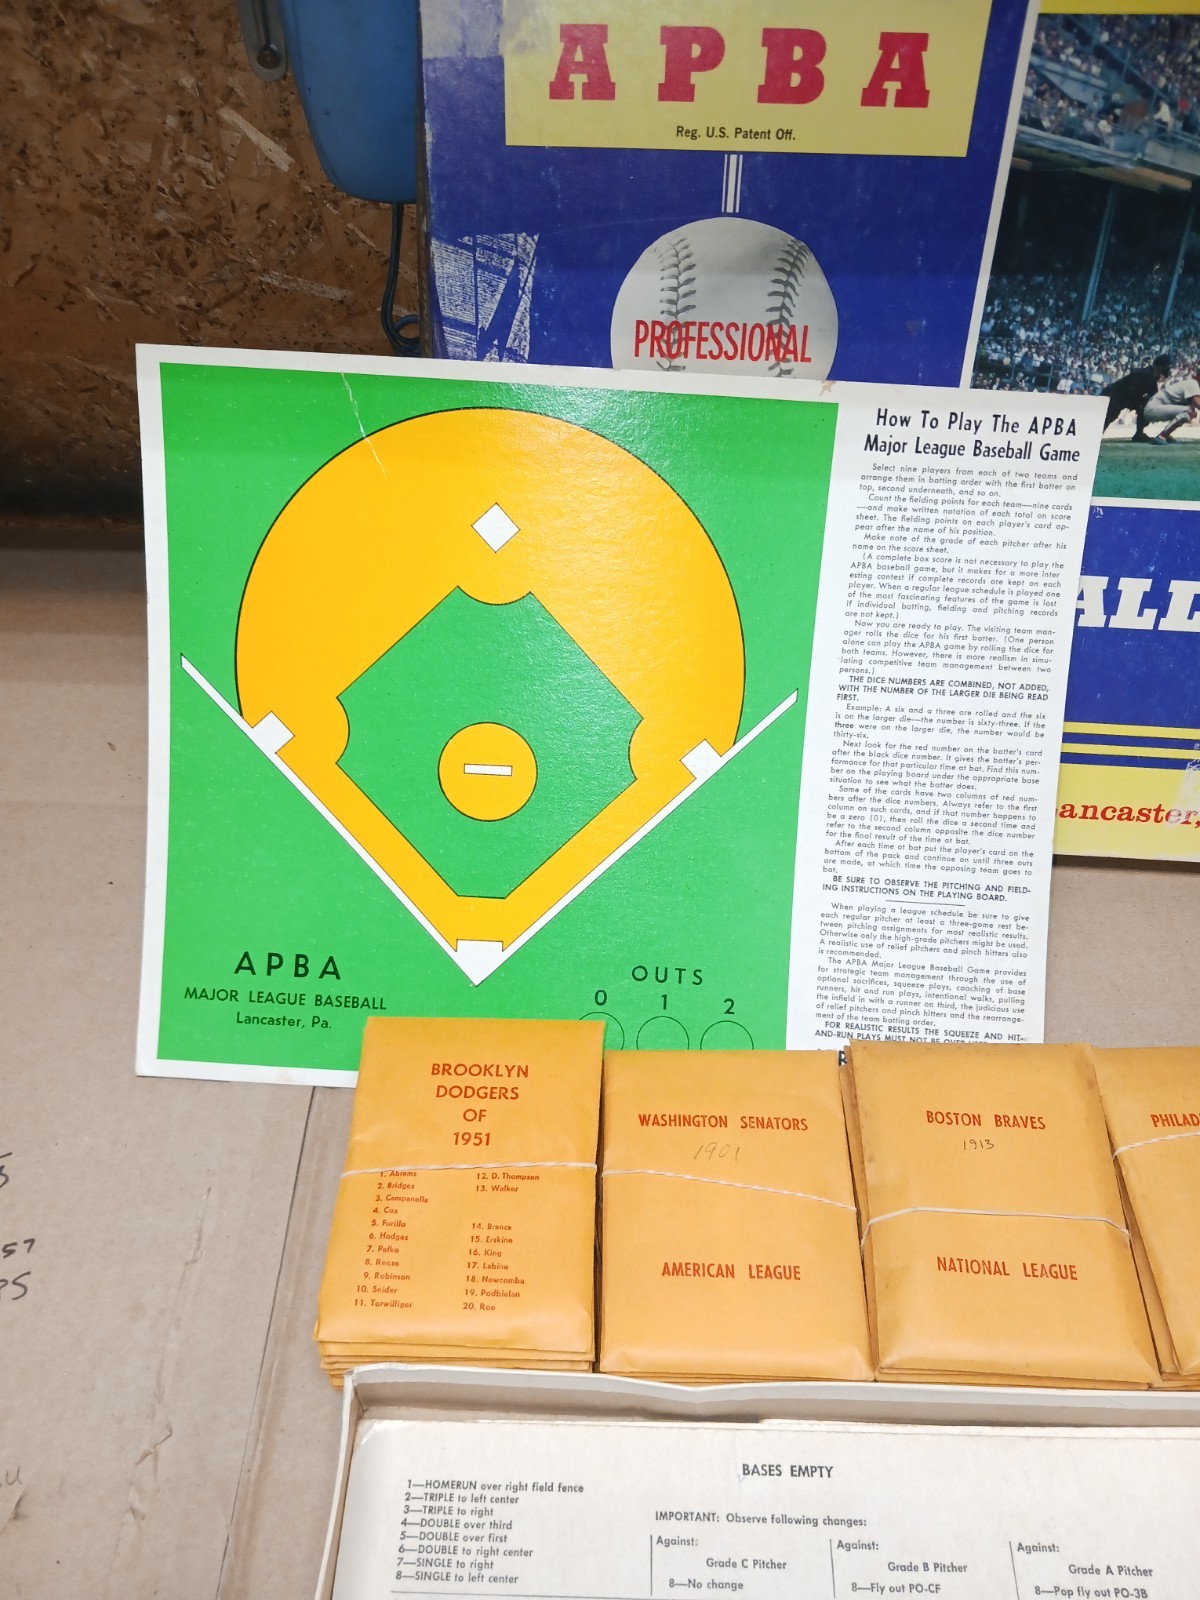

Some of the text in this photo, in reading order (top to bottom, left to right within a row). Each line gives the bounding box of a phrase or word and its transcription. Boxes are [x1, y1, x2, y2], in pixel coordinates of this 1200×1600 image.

[549, 23, 930, 108] APBA
[676, 126, 796, 142] Reg. U.S. Patent Off.
[634, 319, 812, 363] PROFESSIONAL
[876, 408, 1077, 436] How To Play The APBA
[864, 434, 1080, 462] Major League Baseball Game
[867, 676, 884, 684] DICE
[888, 677, 926, 686] NUMBERS
[930, 679, 945, 687] ARE
[948, 680, 994, 689] COMBINED,
[998, 682, 1016, 690] NOT
[1019, 683, 1049, 692] ADDED,
[1054, 803, 1200, 828] ancaster,
[847, 876, 866, 884] SURE
[869, 877, 880, 885] TO
[885, 878, 919, 887] OBSERVE
[924, 880, 938, 888] THE
[942, 881, 980, 891] PITCHING
[985, 884, 1003, 892] AND
[841, 885, 899, 895] INSTRUCTIONS
[903, 888, 916, 896] ON
[920, 889, 934, 897] THE
[938, 890, 973, 900] PLAYING
[977, 892, 1007, 901] BOARD.
[234, 951, 341, 980] APBA
[632, 965, 703, 985] OUTS
[184, 987, 386, 1010] MAJOR LEAGUE BASEBALL
[595, 990, 735, 1014] 0 1 2
[236, 1012, 331, 1029] Lancaster, Pa.
[431, 1063, 529, 1078] BROOKLYN
[436, 1085, 519, 1100] DODGERS
[463, 1109, 487, 1122] OF
[926, 1110, 1046, 1130] BOSTON BRAVES
[638, 1114, 808, 1131] WASHINGTON SENATORS
[453, 1132, 491, 1146] 1951
[964, 1139, 995, 1150] 1913
[694, 1141, 740, 1161] 1901
[502, 1173, 539, 1181] Thompson
[380, 1233, 409, 1241] Hodges
[367, 1245, 374, 1253] 7.
[484, 1249, 502, 1257] King
[661, 1262, 801, 1281] AMERICAN LEAGUE
[937, 1256, 1078, 1280] NATIONAL LEAGUE
[374, 1272, 410, 1280] Robinson
[372, 1286, 397, 1294] Snider
[742, 1463, 833, 1478] BASES EMPTY
[480, 1483, 502, 1491] over
[505, 1481, 529, 1493] right
[532, 1482, 554, 1492] field
[558, 1483, 584, 1493] fence
[457, 1494, 467, 1503] to
[471, 1494, 487, 1503] left
[490, 1495, 519, 1504] center
[457, 1507, 467, 1516] to
[470, 1507, 494, 1518] right
[464, 1521, 486, 1529] over
[489, 1520, 513, 1530] third
[655, 1511, 867, 1528] IMPORTANT: Observe following changes:
[463, 1534, 485, 1542] over
[488, 1533, 507, 1543] first
[656, 1536, 698, 1548] Against:
[462, 1547, 472, 1555] to
[476, 1546, 499, 1558] right
[503, 1548, 533, 1557] center
[837, 1540, 879, 1552] Against:
[1017, 1543, 1060, 1554] Against:
[456, 1560, 466, 1568] to
[470, 1559, 494, 1571] right
[706, 1558, 787, 1570] Grade C Pitcher
[888, 1562, 967, 1574] Grade B Pitcher
[1069, 1565, 1153, 1577] Grade A Pitcher
[454, 1573, 464, 1582] to
[468, 1573, 484, 1583] left
[488, 1575, 519, 1584] center
[707, 1580, 744, 1591] change
[889, 1585, 905, 1594] out
[1077, 1586, 1091, 1599] fly
[1094, 1588, 1111, 1597] out
